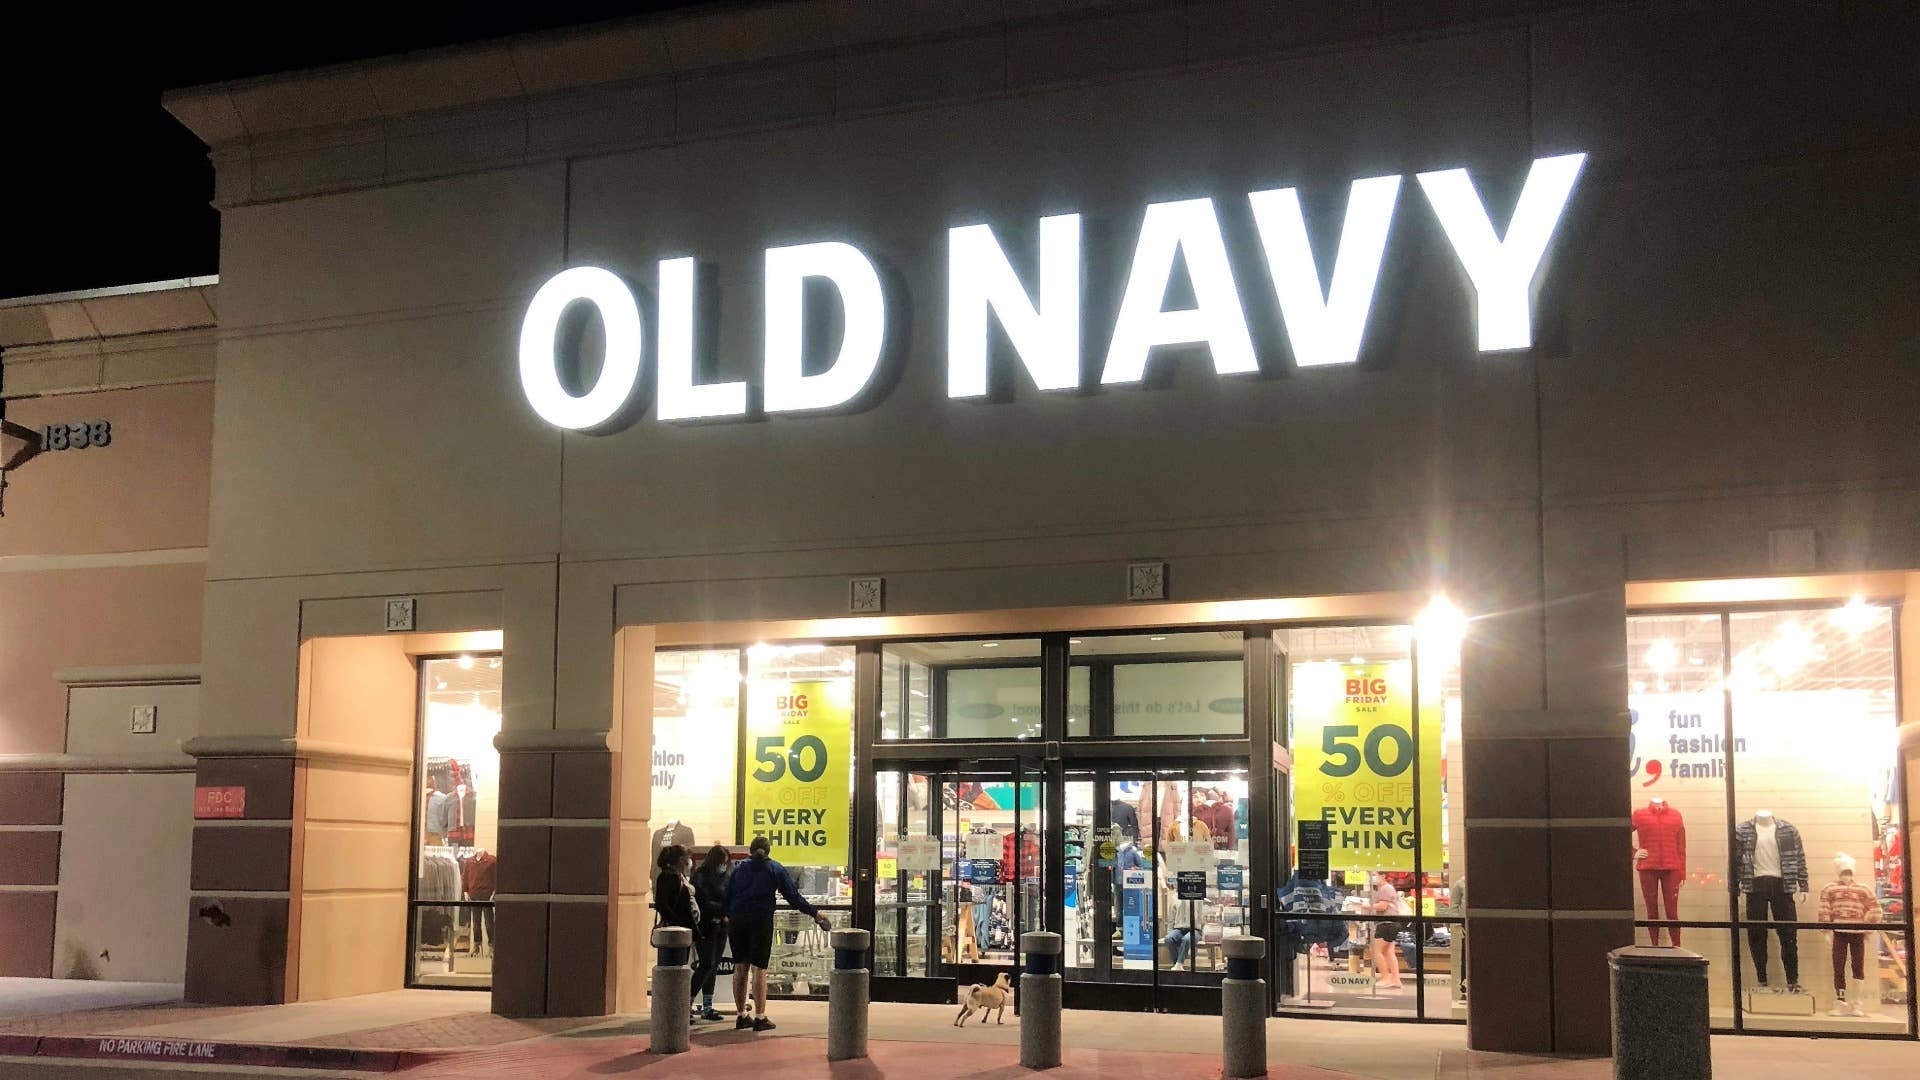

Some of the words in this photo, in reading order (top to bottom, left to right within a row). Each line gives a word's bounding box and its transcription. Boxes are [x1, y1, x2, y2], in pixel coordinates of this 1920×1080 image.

[519, 242, 886, 431] OLD
[947, 152, 1588, 399] NAVY
[40, 420, 111, 450] 1838
[1345, 679, 1386, 695] BIG
[776, 694, 809, 710] BIG
[1345, 696, 1388, 704] FRIDAY
[779, 710, 809, 718] RIDAY
[1668, 709, 1702, 729] fun
[753, 734, 828, 783] 50
[1319, 723, 1414, 778] 50
[1669, 758, 1726, 778] famil
[208, 791, 232, 803] FDC
[777, 786, 829, 806] OFF
[1352, 782, 1414, 803] OFF
[753, 808, 828, 826] EVERY
[1321, 806, 1415, 826] EVERY
[752, 829, 827, 847] THING
[1327, 830, 1415, 849] THING
[716, 961, 735, 971] NAV
[781, 960, 795, 968] OLD
[99, 1039, 115, 1053] NO
[117, 1040, 161, 1055] PARKING
[163, 1041, 187, 1056] FIRE
[188, 1043, 216, 1058] LANE
